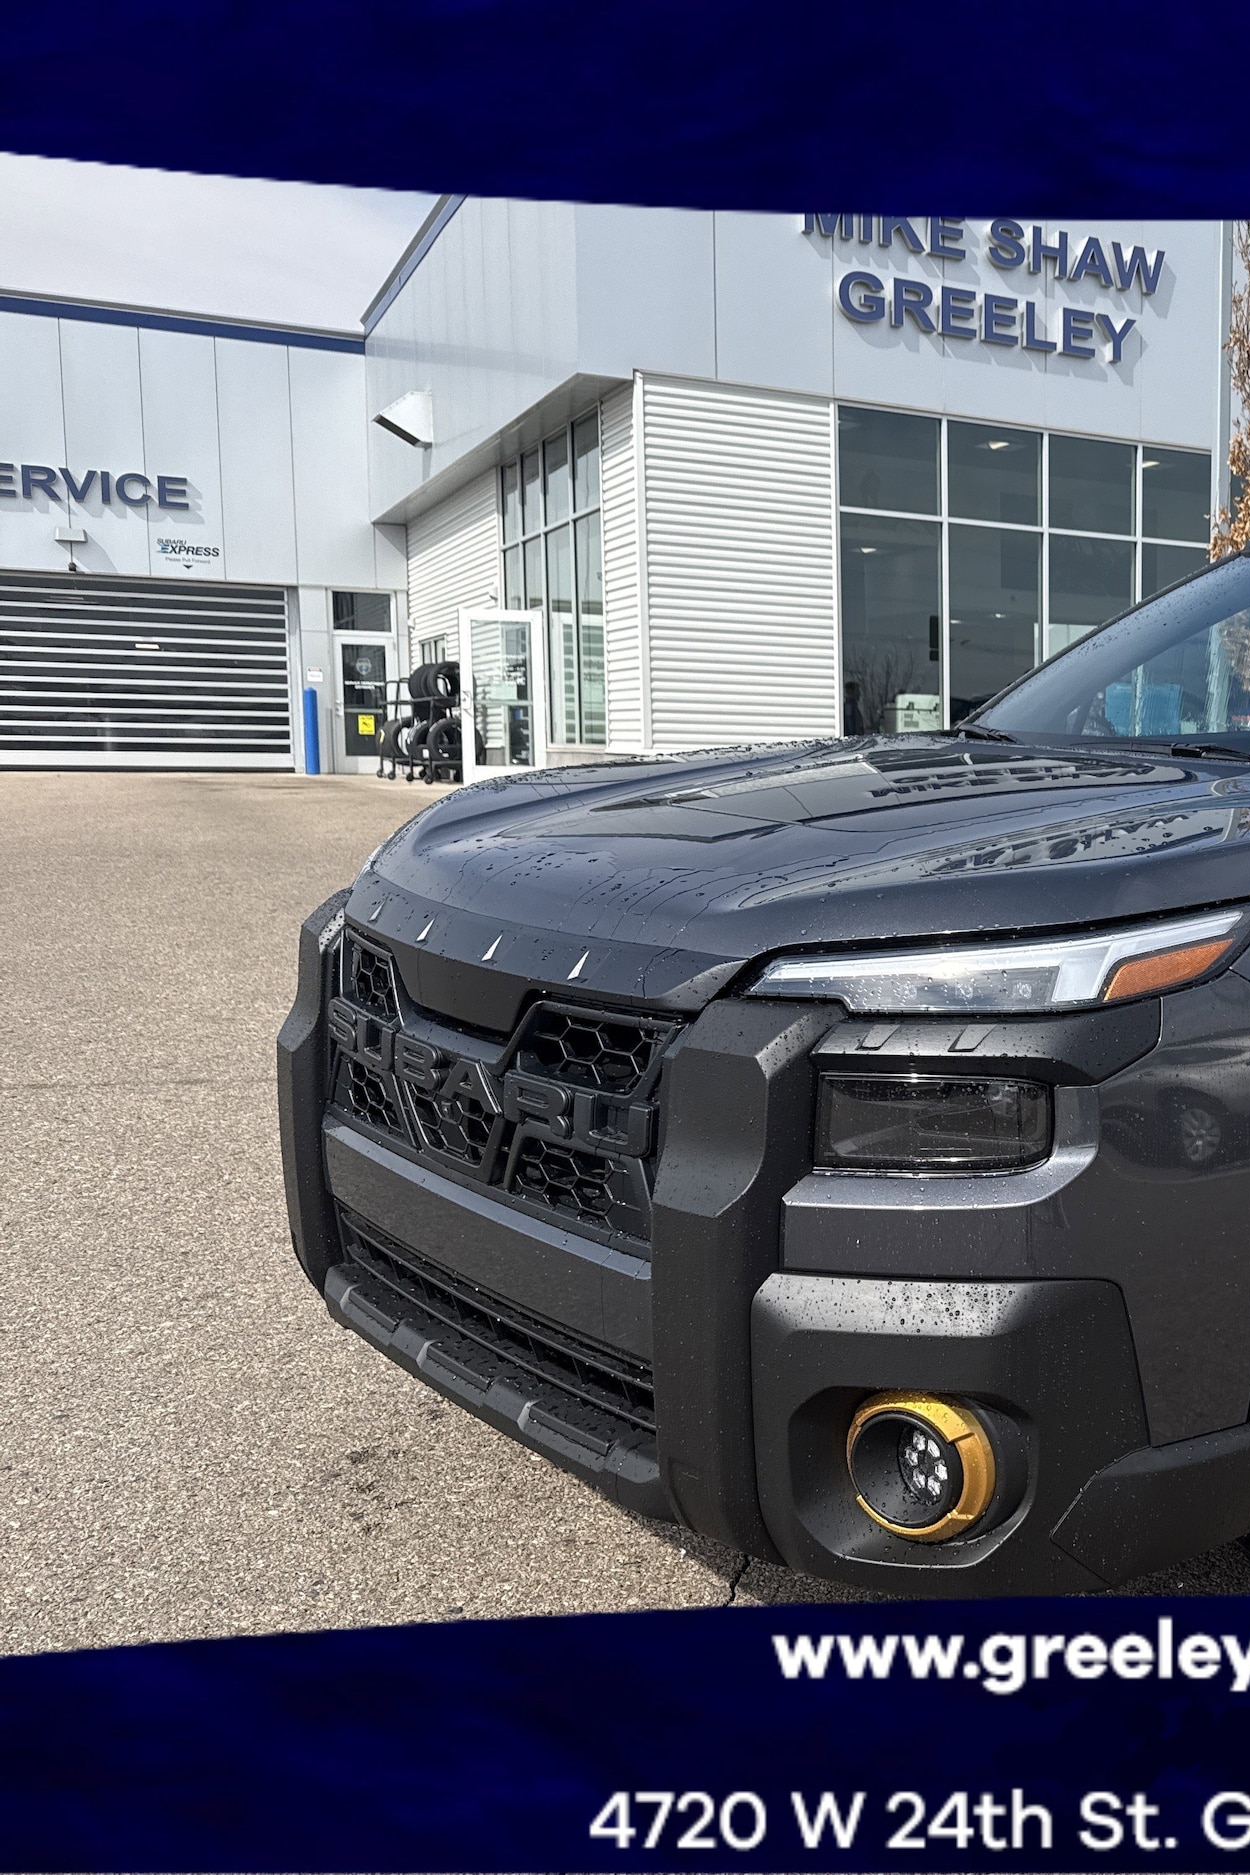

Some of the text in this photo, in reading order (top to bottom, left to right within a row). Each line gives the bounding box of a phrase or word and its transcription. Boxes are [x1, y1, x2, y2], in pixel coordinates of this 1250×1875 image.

[987, 217, 1166, 295] SHAW
[836, 270, 1137, 363] GREELEY
[156, 537, 187, 546] SUBARU
[157, 543, 220, 558] EXPRESS
[327, 998, 659, 1158] SUBARU
